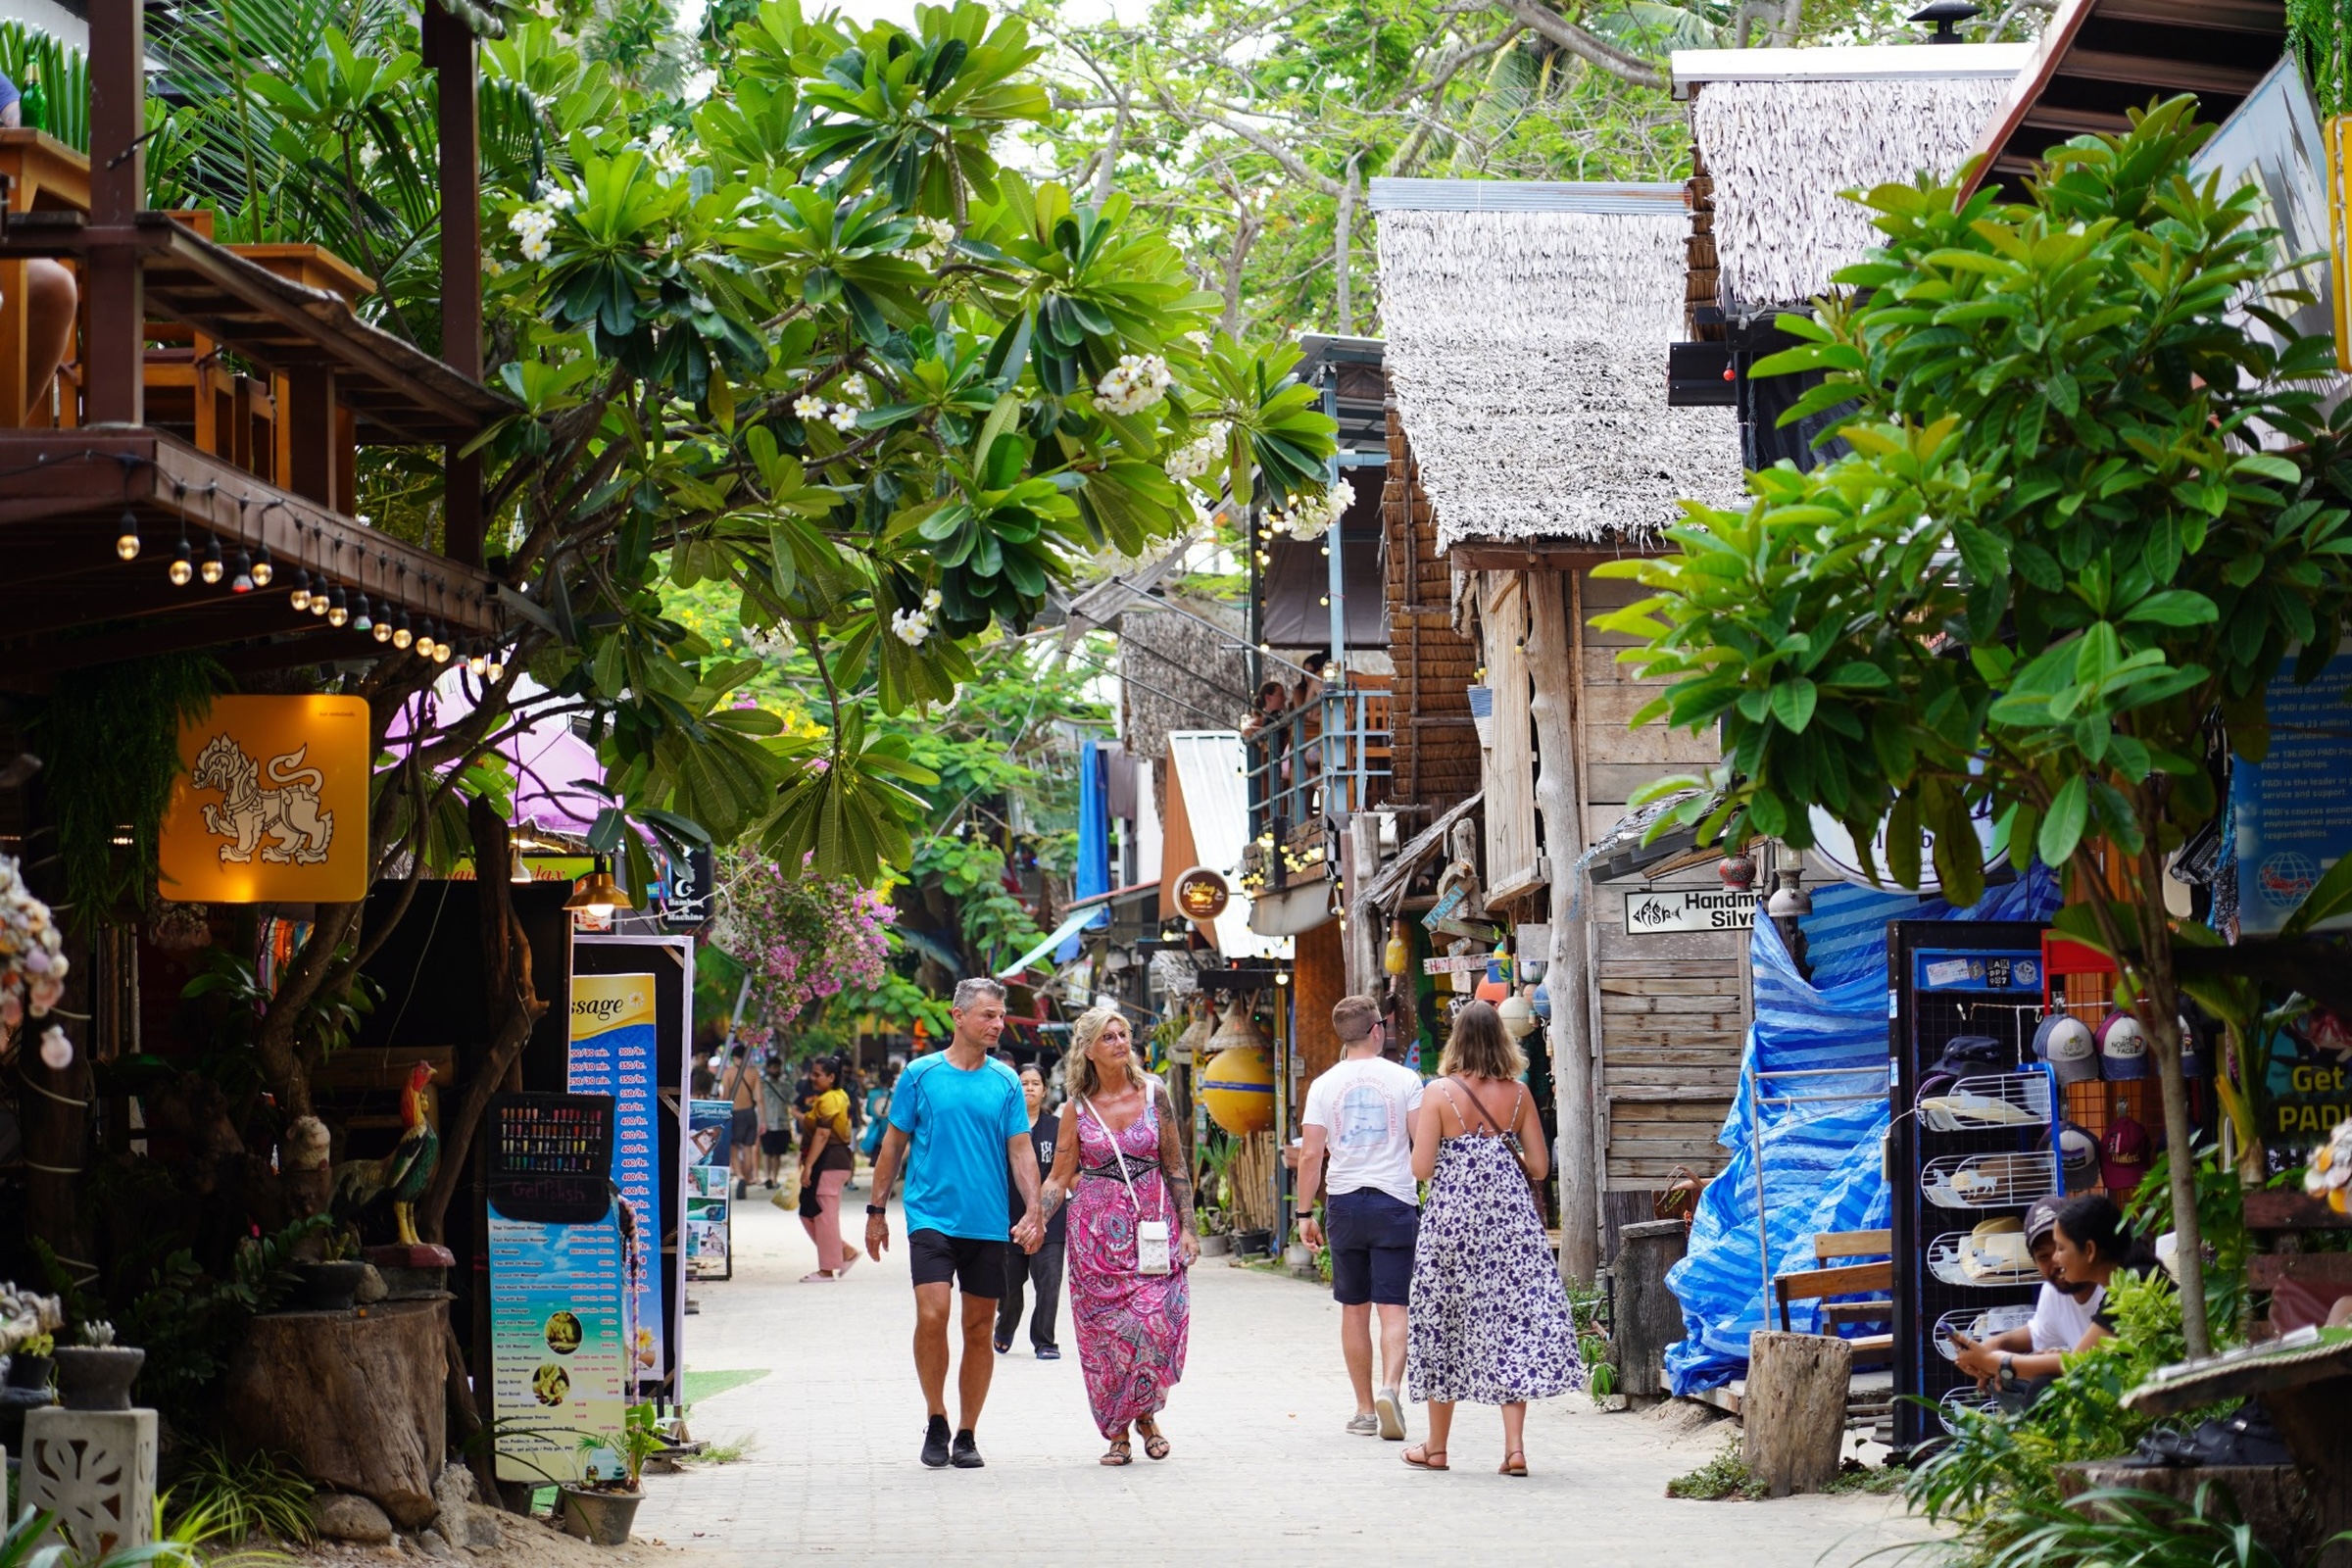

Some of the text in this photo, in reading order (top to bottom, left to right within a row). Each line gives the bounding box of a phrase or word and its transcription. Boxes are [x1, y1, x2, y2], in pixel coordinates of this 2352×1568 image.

[2266, 686, 2303, 697] cognized
[2261, 761, 2281, 771] PADI
[2262, 779, 2282, 788] PADI
[2309, 777, 2336, 786] leader
[2263, 791, 2293, 801] service
[2294, 790, 2311, 799] and
[2291, 808, 2324, 816] courses
[2264, 819, 2324, 828] environmental
[1426, 885, 1467, 927] TONSAI
[666, 912, 705, 922] Machine
[570, 998, 624, 1021] sage
[2292, 1064, 2345, 1093] Get
[512, 1179, 540, 1199] Gel
